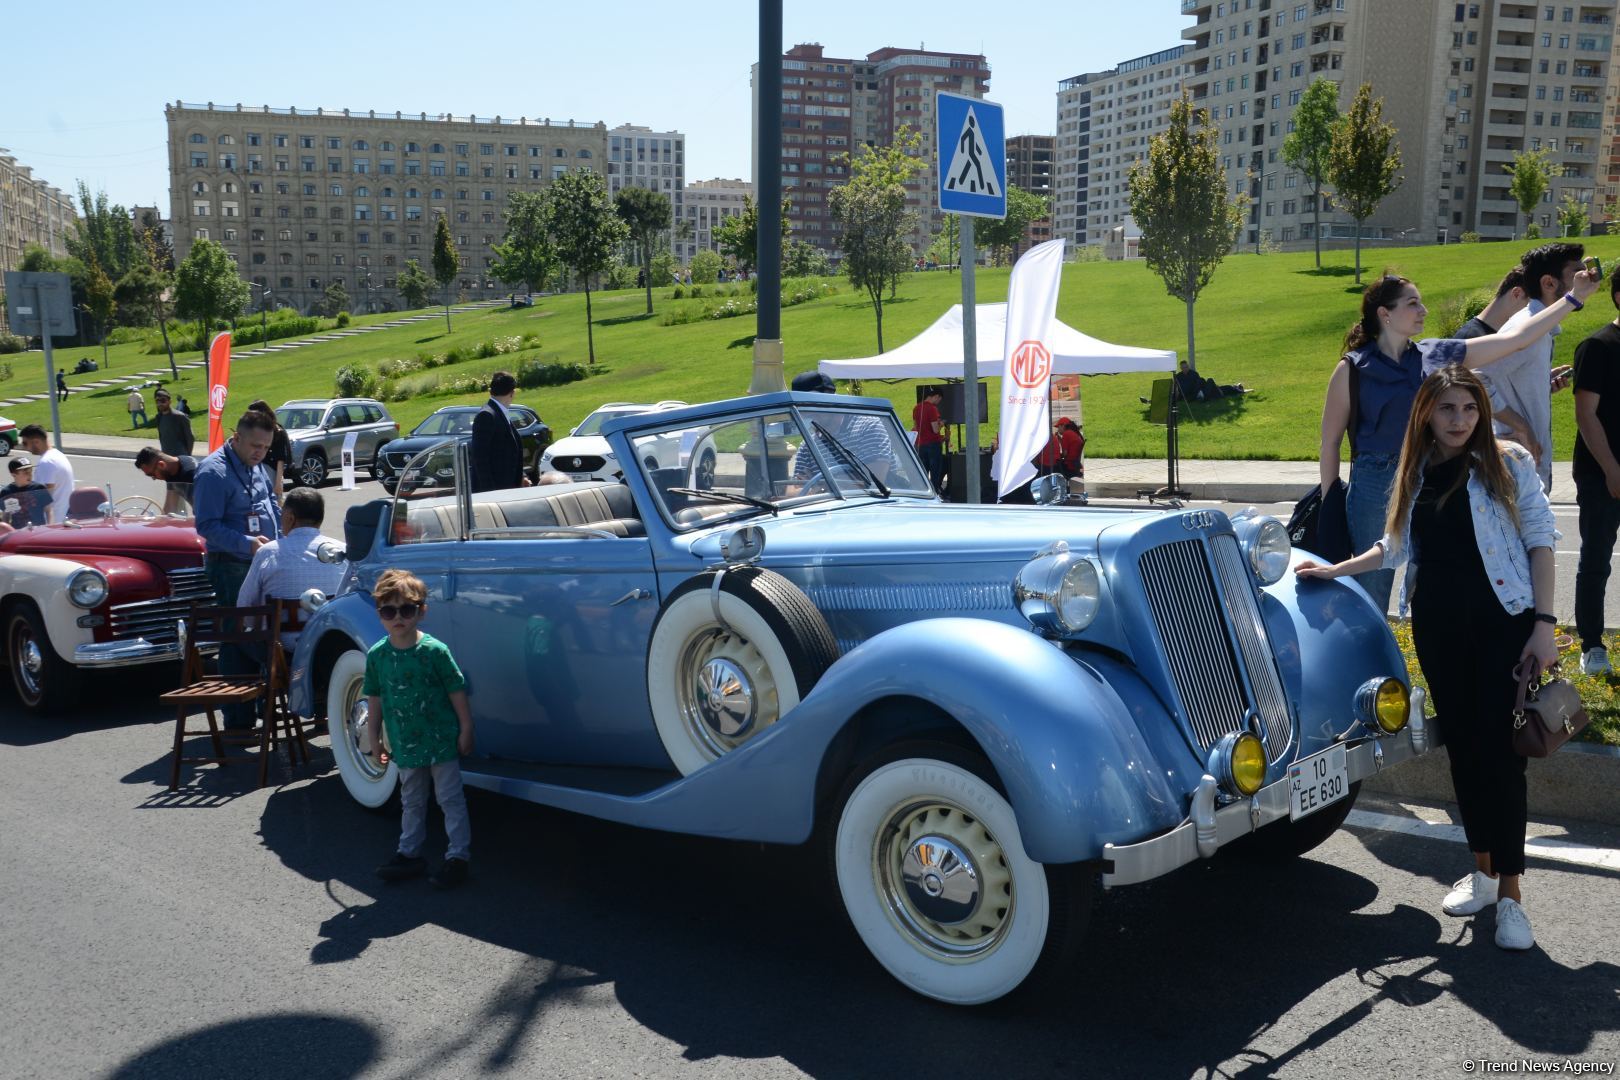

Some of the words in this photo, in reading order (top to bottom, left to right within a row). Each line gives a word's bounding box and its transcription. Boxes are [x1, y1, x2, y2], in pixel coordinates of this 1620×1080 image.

[1014, 345, 1047, 384] MG
[1008, 395, 1027, 405] Since
[1313, 757, 1327, 780] 10
[1292, 779, 1302, 793] AZ
[1300, 786, 1318, 812] EE
[1320, 775, 1342, 802] 630
